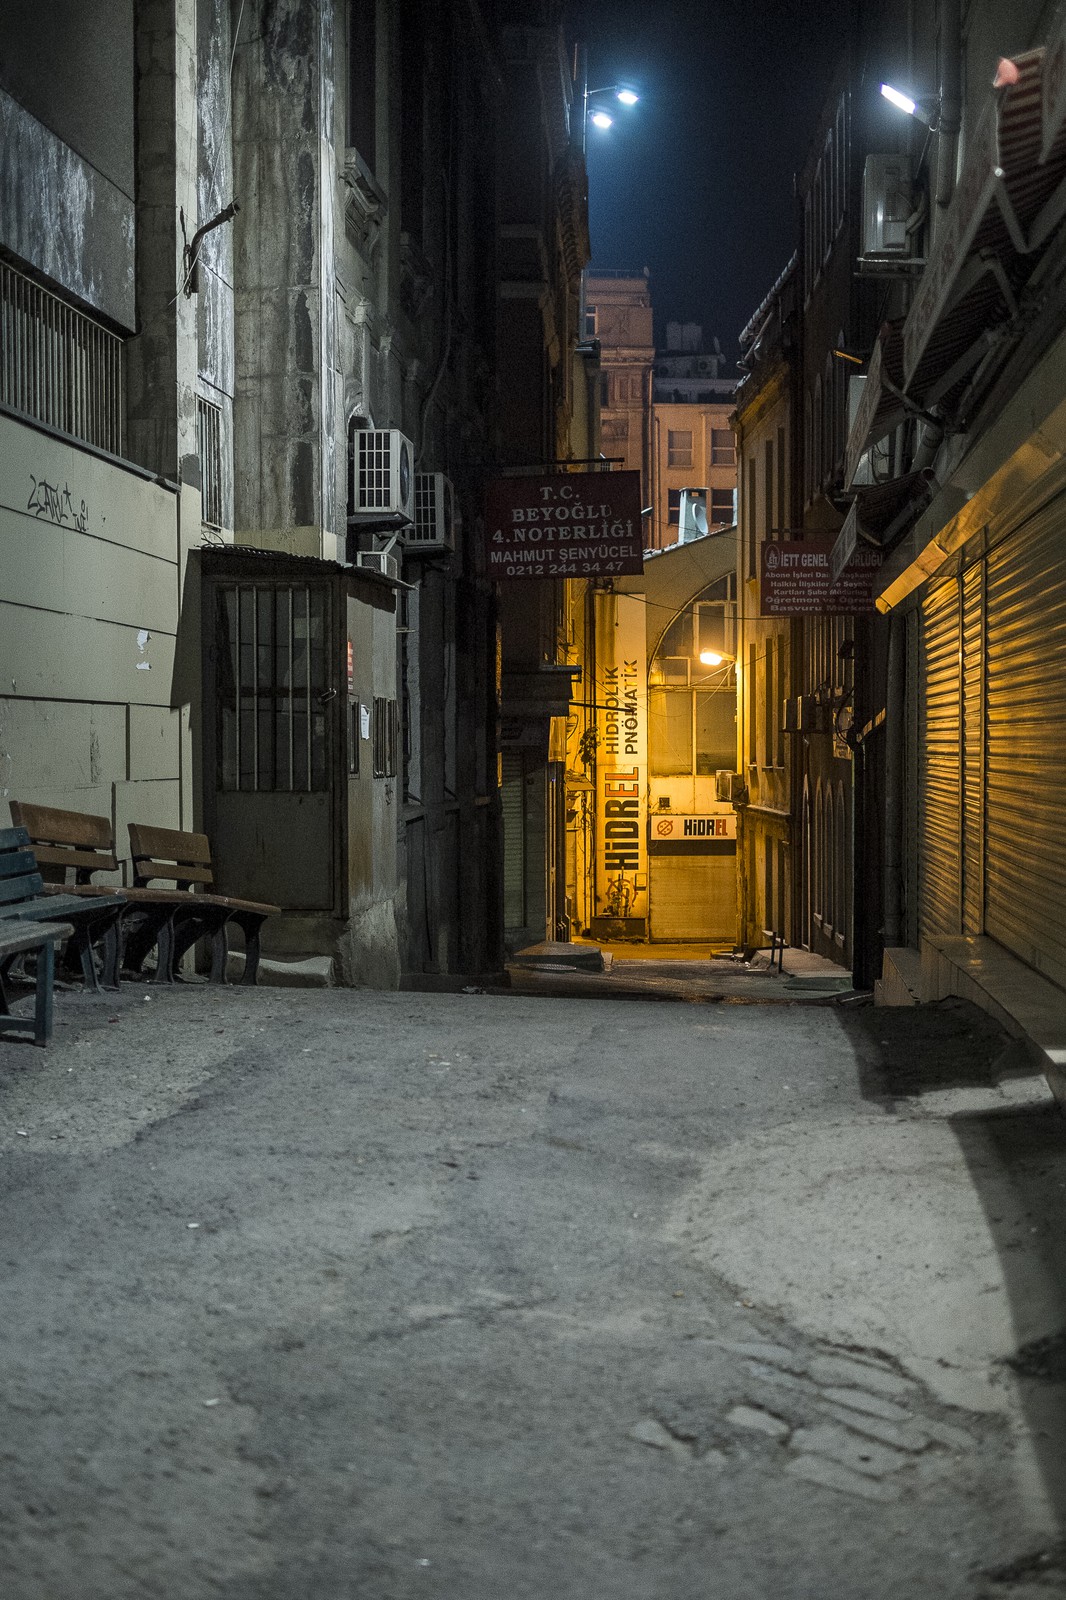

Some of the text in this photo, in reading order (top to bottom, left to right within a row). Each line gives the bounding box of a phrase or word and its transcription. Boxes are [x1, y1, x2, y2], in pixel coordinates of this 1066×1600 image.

[540, 486, 580, 500] T.C.
[512, 502, 612, 522] BEYOĞLU
[492, 519, 633, 543] 4.NOTERLİĞİ
[490, 545, 638, 563] MAHMUT ŞENYÜCEL
[781, 551, 800, 567] İETT
[801, 554, 829, 567] GENEL
[506, 561, 624, 576] 0212 244 34 47
[765, 571, 792, 579] Abone
[815, 571, 830, 579] Dai
[807, 589, 828, 597] Şube
[602, 666, 620, 755] HİDROLİK
[621, 659, 638, 755] PNÖMATİK
